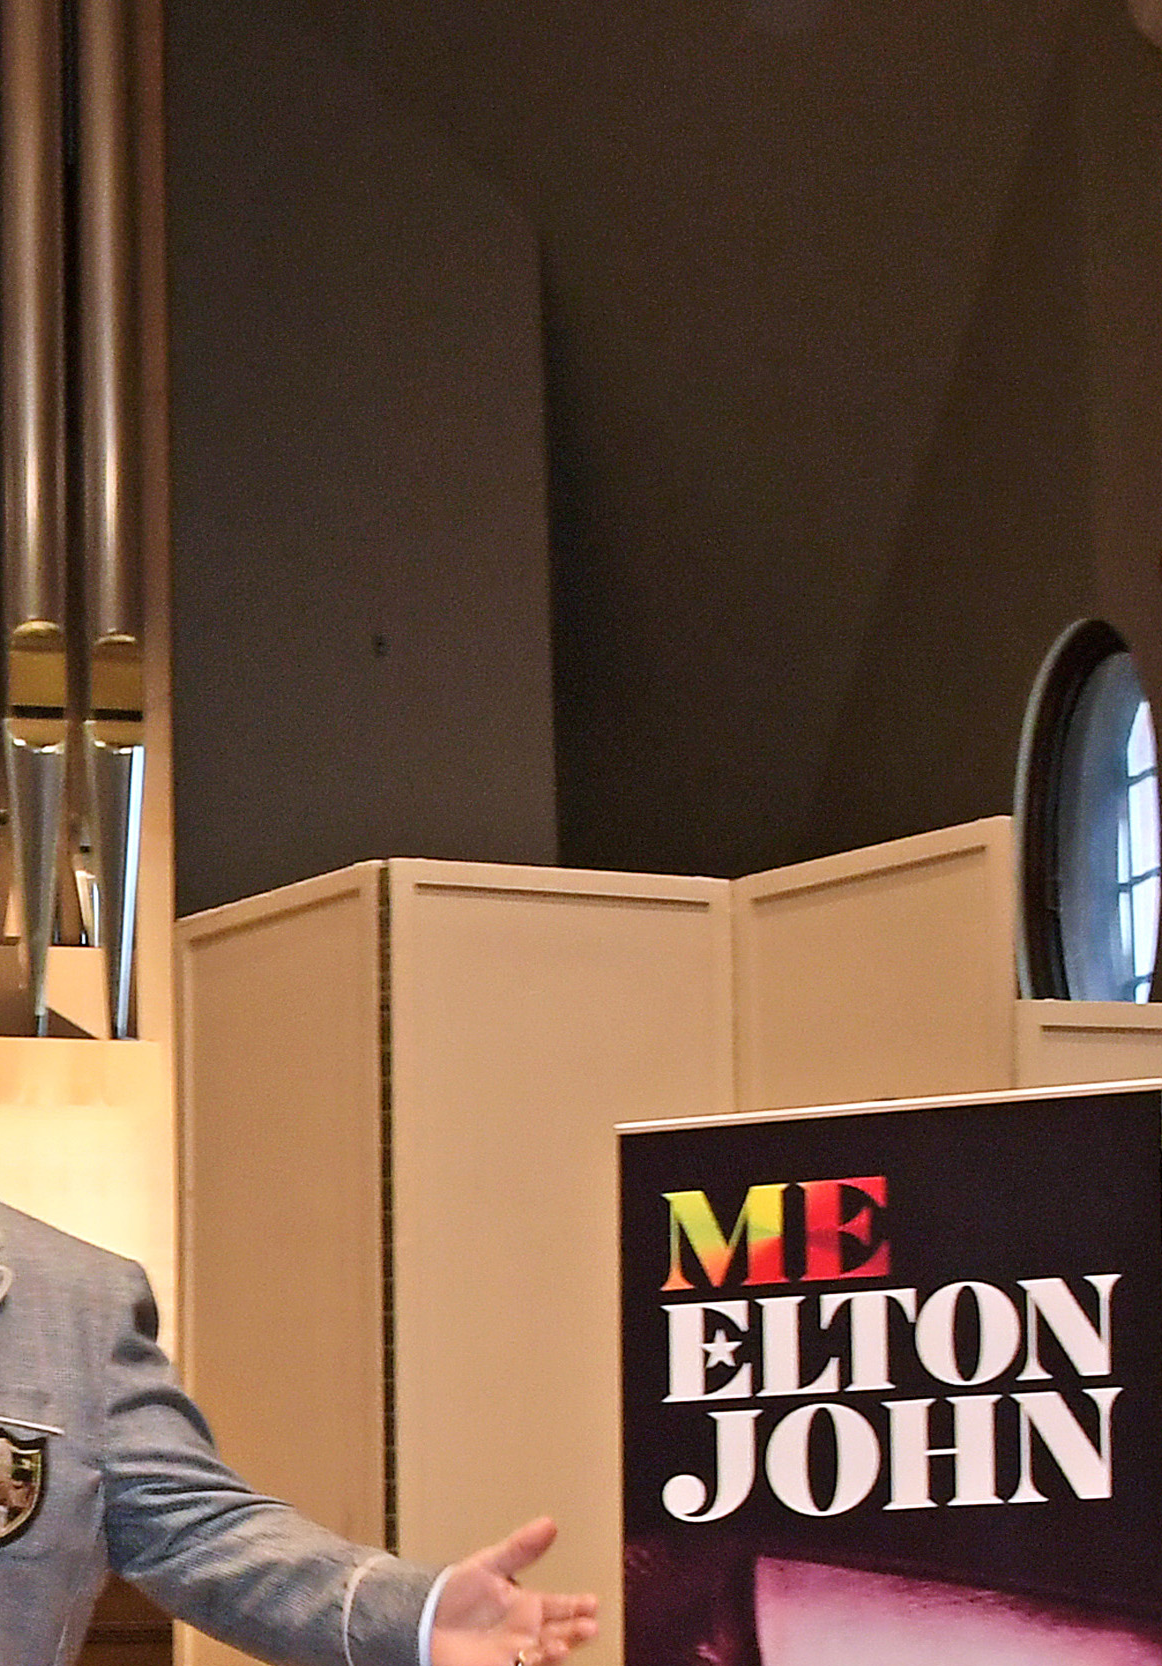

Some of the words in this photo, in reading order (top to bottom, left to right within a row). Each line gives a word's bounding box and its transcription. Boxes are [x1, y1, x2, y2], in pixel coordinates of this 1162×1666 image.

[661, 1176, 891, 1291] ME
[661, 1273, 1122, 1402] ELTON
[661, 1387, 1123, 1522] JOHN
